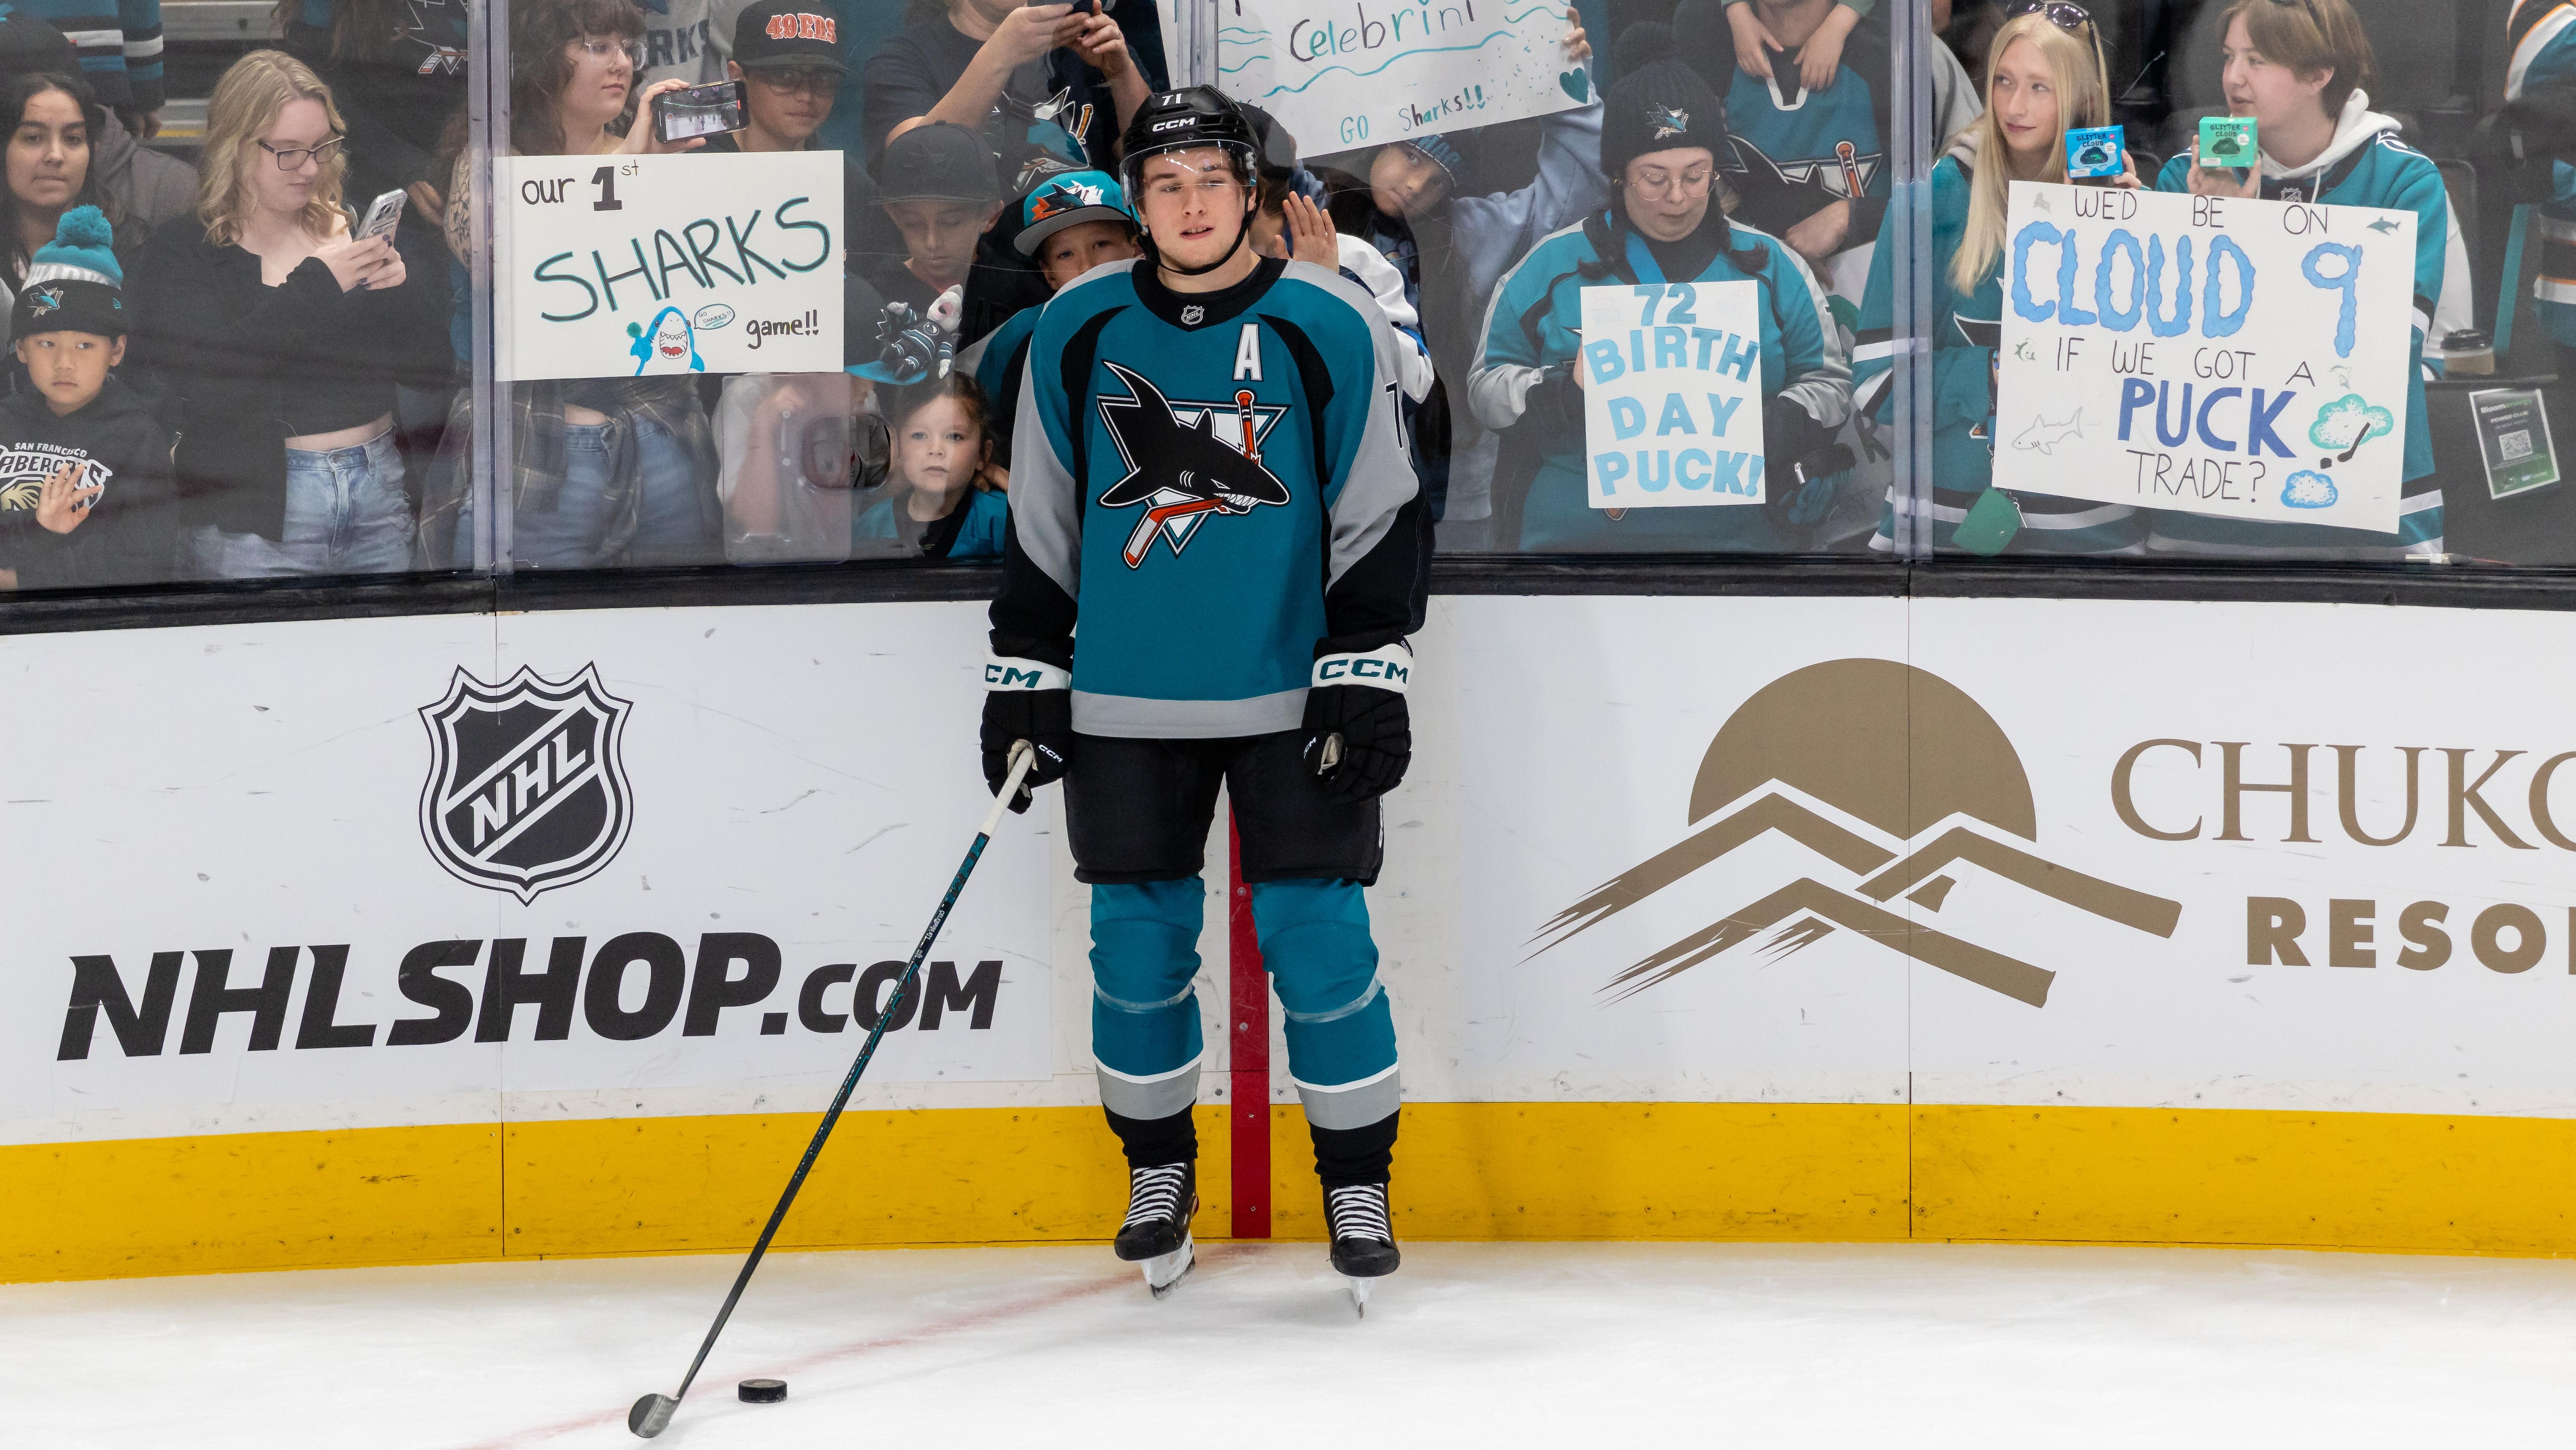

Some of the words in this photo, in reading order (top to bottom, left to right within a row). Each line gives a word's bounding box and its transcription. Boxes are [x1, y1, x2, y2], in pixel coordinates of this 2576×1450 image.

[766, 13, 837, 44] 49ERS
[1162, 93, 1182, 106] 71
[1340, 115, 1369, 144] GO
[1398, 85, 1486, 131] Sharks!!
[1152, 117, 1196, 132] CCM
[2076, 133, 2107, 141] GLITTER
[522, 178, 575, 205] our
[2075, 188, 2138, 220] WE'D
[2192, 195, 2225, 228] BE
[2283, 204, 2329, 235] ON
[534, 197, 831, 323] SHARKS
[1634, 282, 1697, 327] 72
[2011, 220, 2256, 338] CLOUD
[2301, 241, 2363, 358] 9
[747, 309, 819, 349] game!!
[1186, 310, 1200, 321] NHL
[1233, 324, 1263, 381] A
[1584, 326, 1761, 386] BIRTH
[2057, 336, 2084, 372] IF
[2112, 339, 2155, 376] WE
[2194, 347, 2256, 381] GOT
[2285, 361, 2316, 387] A
[1607, 393, 1743, 441] DAY
[2117, 378, 2297, 458] PUCK
[14, 442, 35, 450] SAN
[37, 443, 88, 458] FRANCISCO
[1594, 448, 1766, 498] PUCK!
[2126, 449, 2266, 503] TRADE?
[1319, 659, 1408, 684] CCM
[1038, 744, 1063, 763] CCM
[469, 728, 586, 849] NHL
[2247, 896, 2576, 974] RESO
